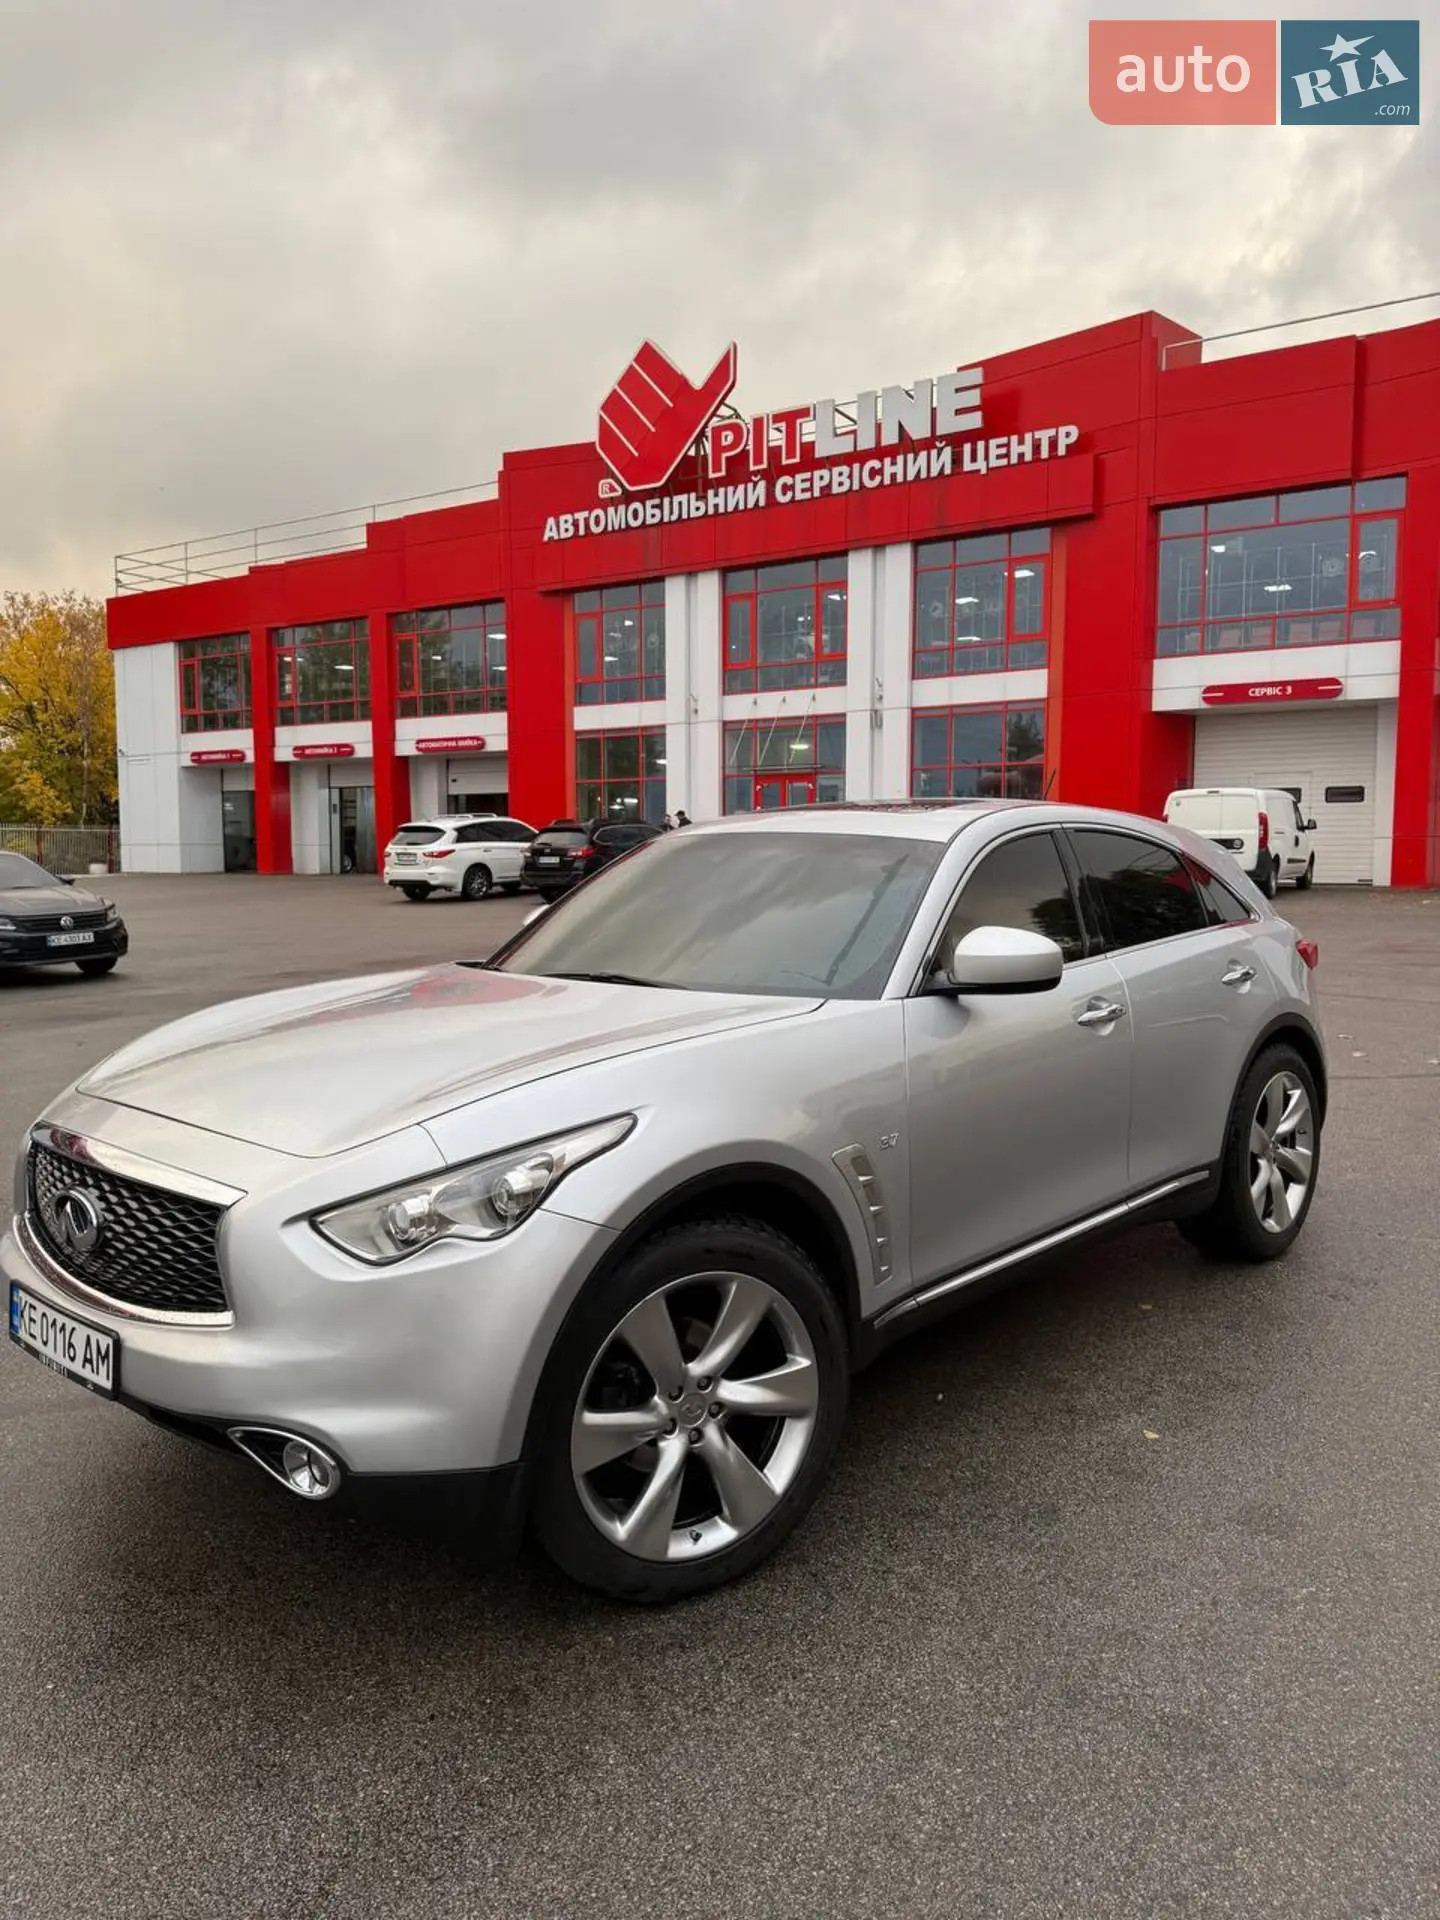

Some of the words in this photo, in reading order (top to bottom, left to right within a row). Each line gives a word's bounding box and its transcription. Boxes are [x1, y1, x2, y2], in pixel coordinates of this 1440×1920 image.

[708, 367, 984, 478] PITLINE
[542, 473, 767, 541] АВТОМОБІЛЬНИЙ
[775, 440, 953, 503] СЕРВІСНИЙ
[962, 424, 1079, 475] ЦЕНТР
[1248, 687, 1283, 696] СЕРВІС
[1285, 685, 1292, 694] 3
[20, 1300, 37, 1340] KE
[40, 1312, 76, 1362] 0116
[82, 1333, 110, 1381] AM
